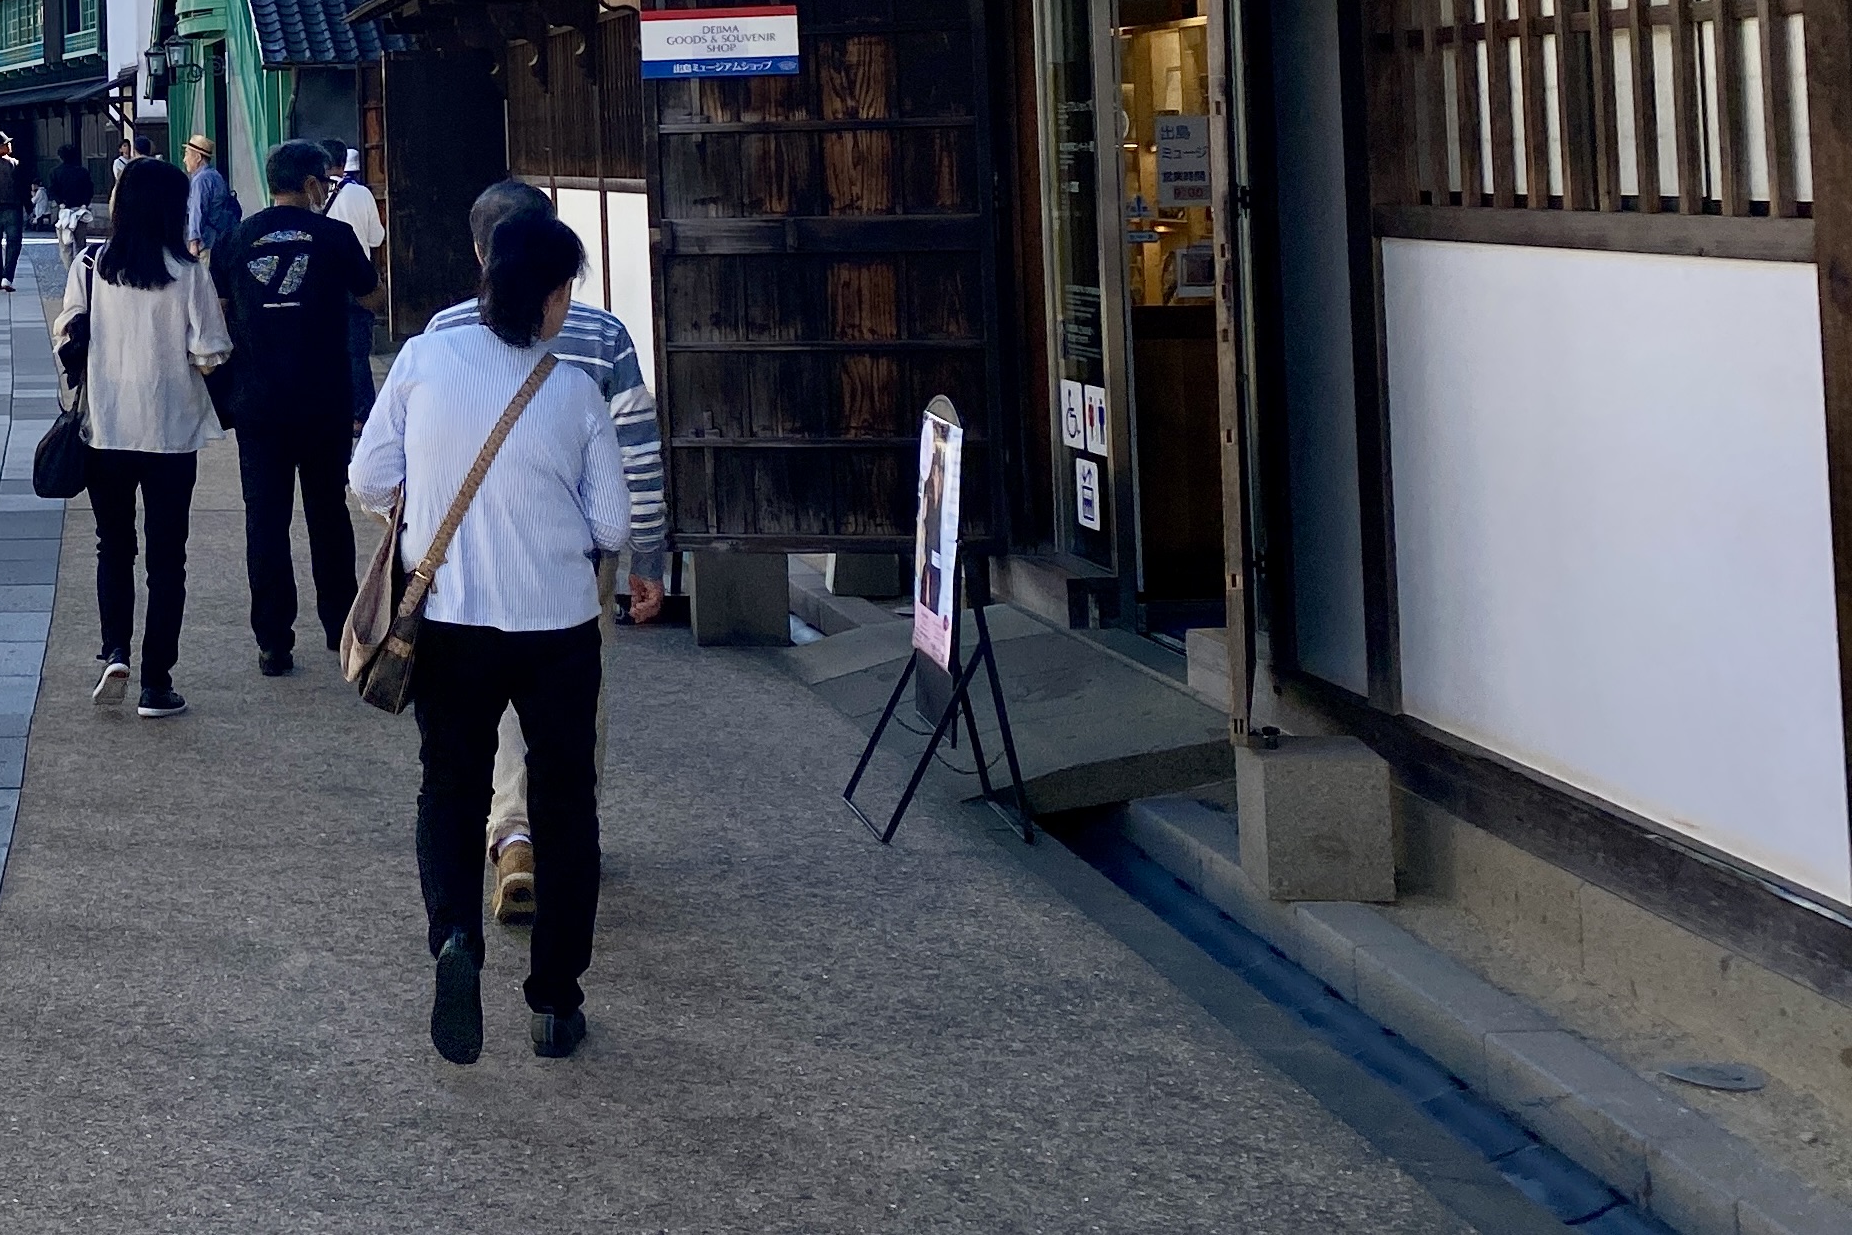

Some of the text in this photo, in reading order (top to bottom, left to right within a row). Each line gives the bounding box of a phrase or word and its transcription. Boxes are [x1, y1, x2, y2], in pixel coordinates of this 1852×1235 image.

[702, 25, 739, 35] DEJIMA
[666, 32, 776, 45] GOODS & SOUVENIR
[706, 43, 737, 53] SHOP
[1161, 124, 1190, 140] 出島
